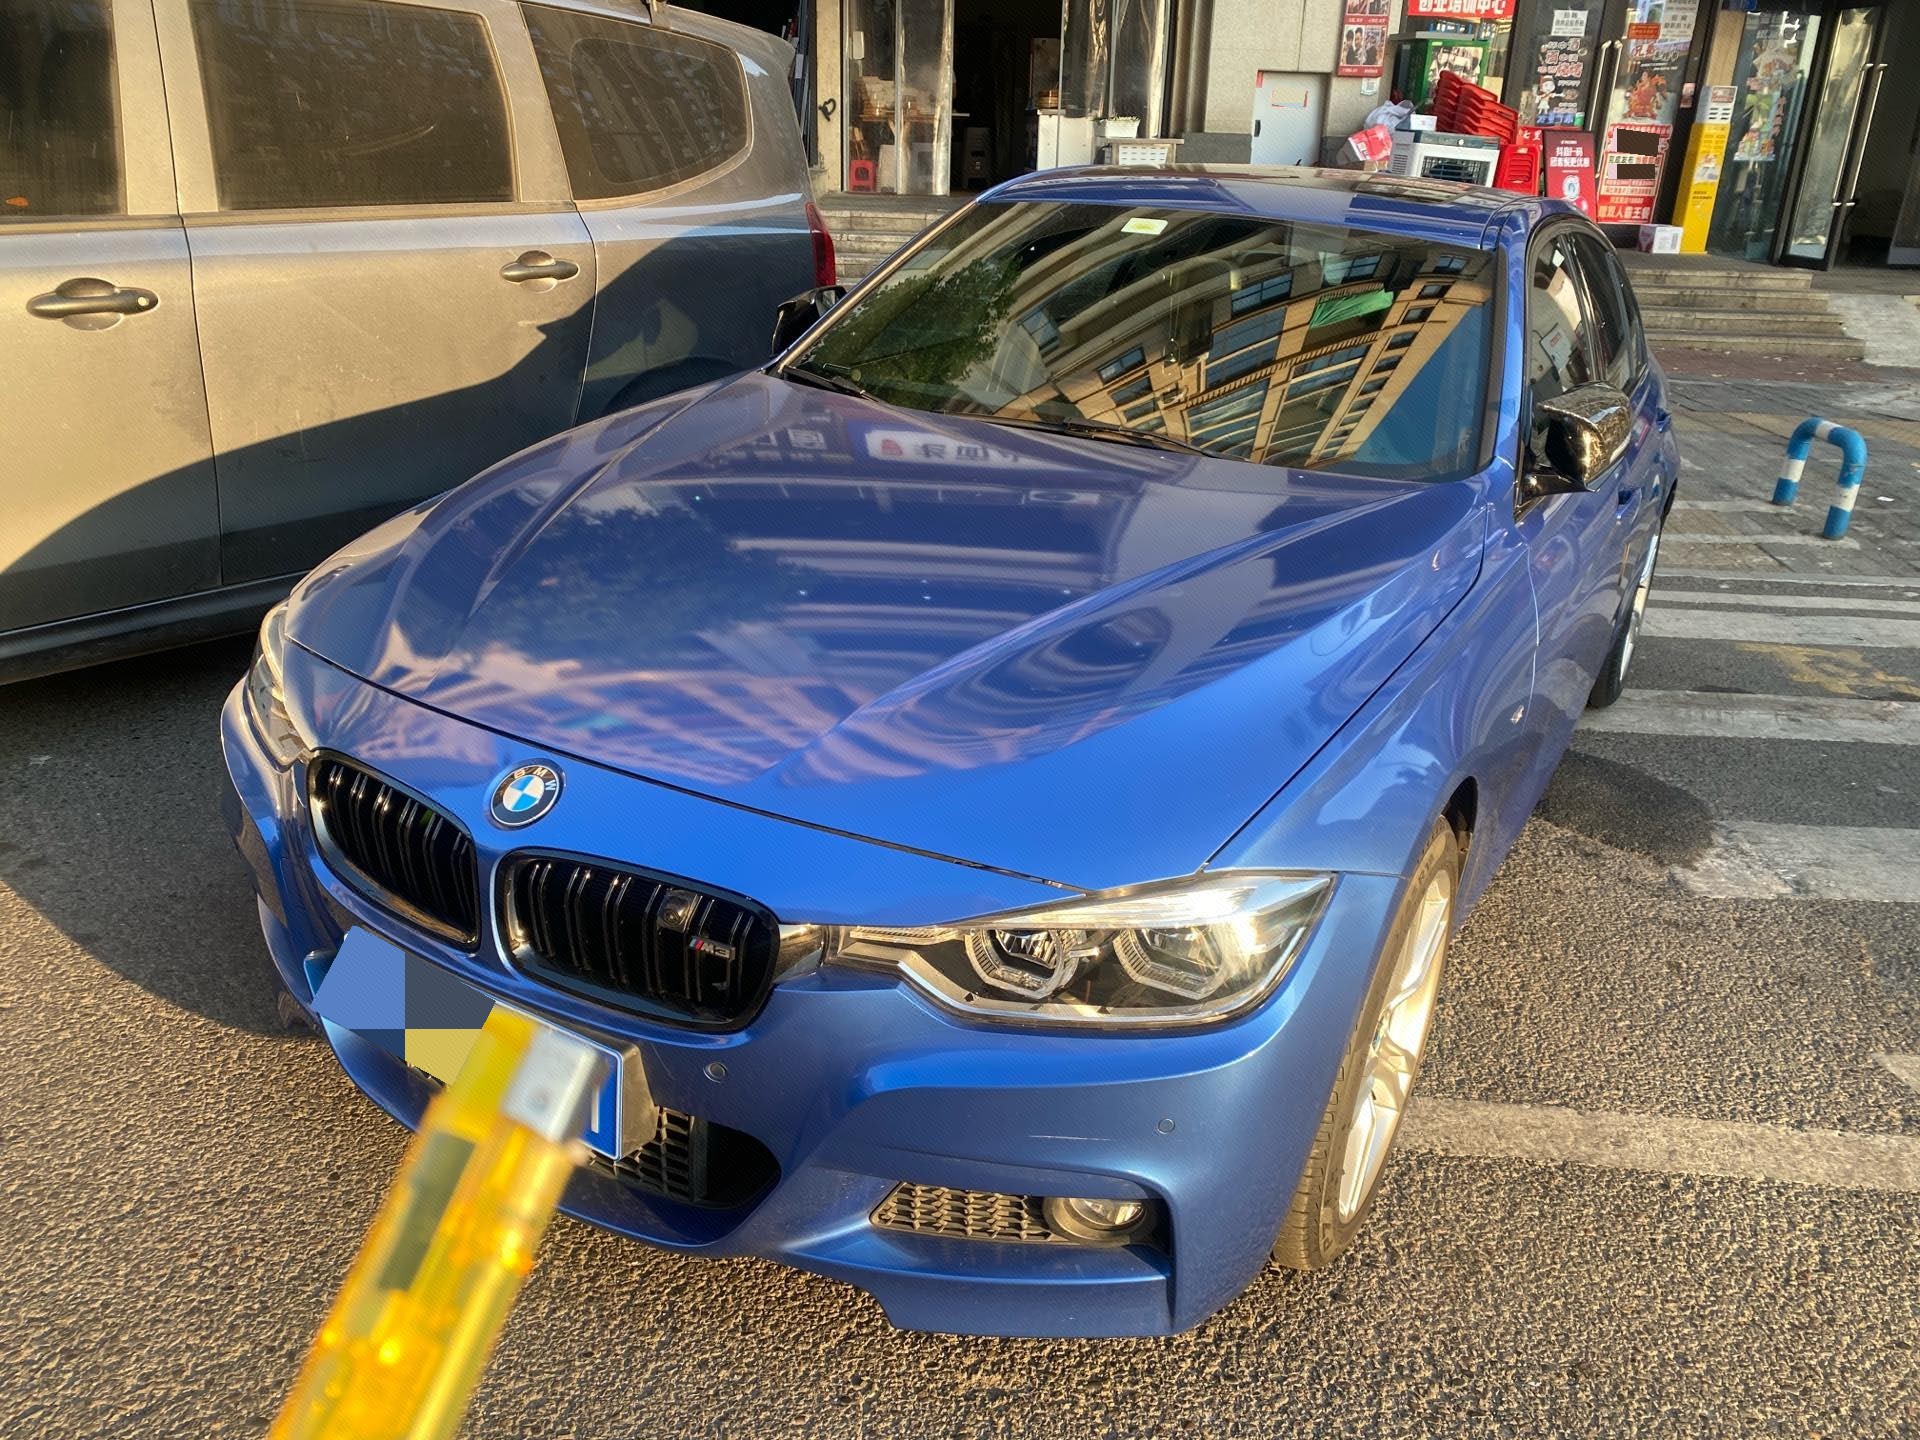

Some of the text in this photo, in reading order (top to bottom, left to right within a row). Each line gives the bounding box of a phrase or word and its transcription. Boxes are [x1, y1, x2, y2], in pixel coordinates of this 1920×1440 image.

[1418, 0, 1506, 13] 创业培训中心
[513, 767, 557, 791] BMW
